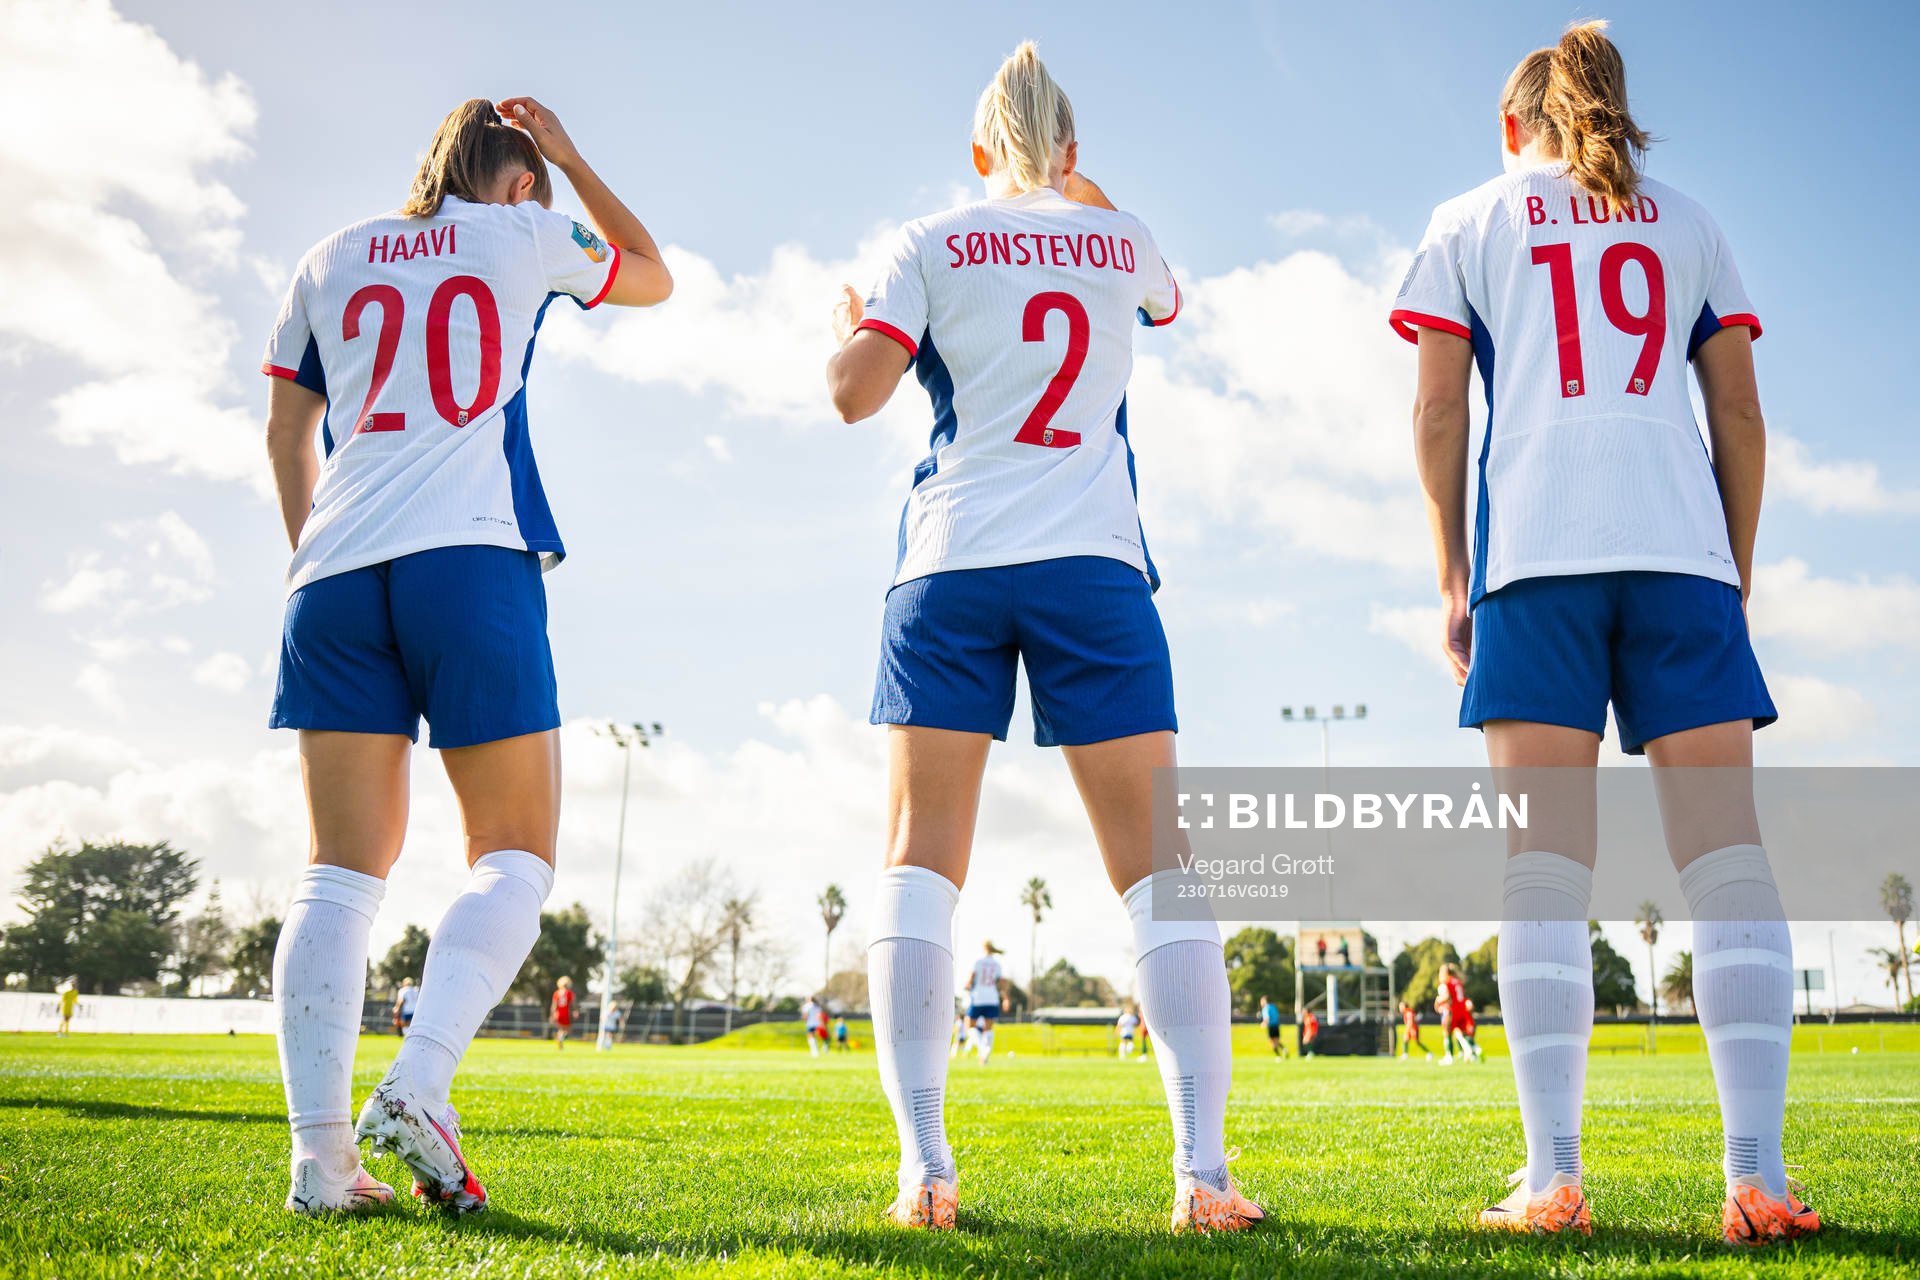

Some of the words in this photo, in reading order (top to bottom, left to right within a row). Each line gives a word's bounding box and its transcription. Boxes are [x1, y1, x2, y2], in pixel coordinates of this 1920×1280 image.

[368, 224, 455, 263] HAAVI
[945, 231, 1136, 273] SØNSTEVOLD
[1526, 195, 1558, 226] B.
[1569, 194, 1659, 225] LUND
[342, 275, 502, 437] 20
[1531, 241, 1667, 398] 19
[1013, 291, 1091, 449] 2
